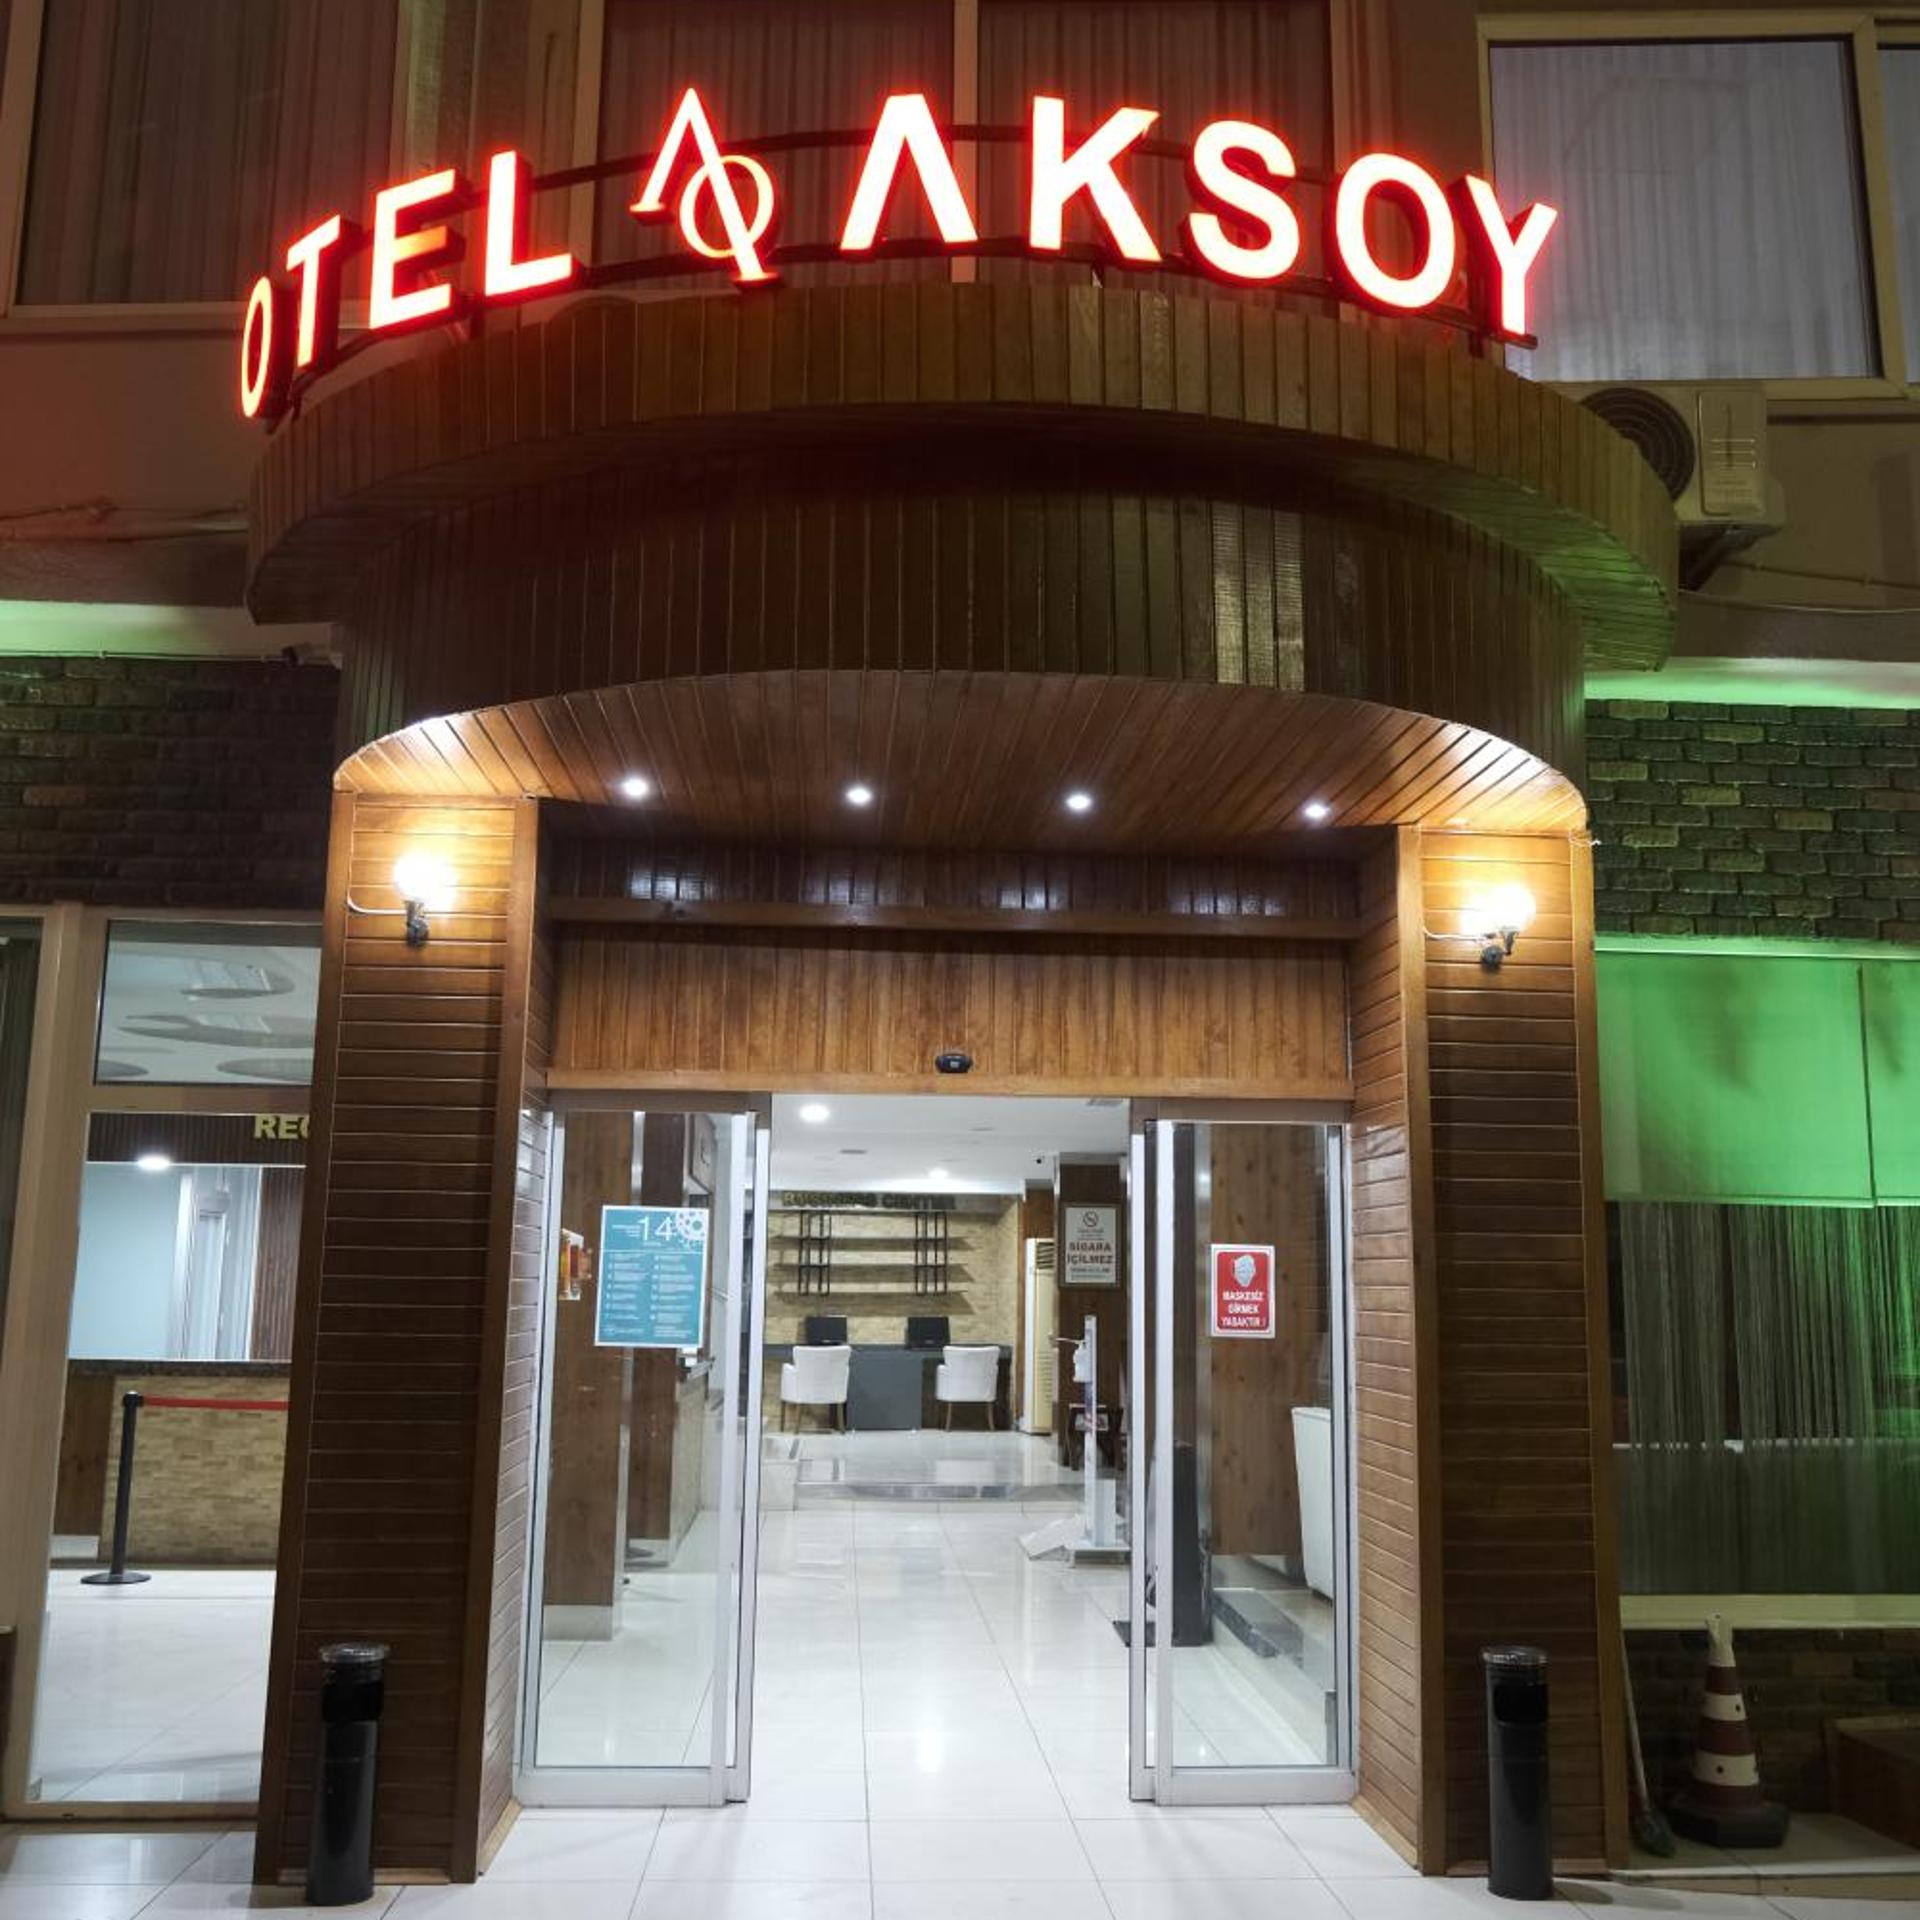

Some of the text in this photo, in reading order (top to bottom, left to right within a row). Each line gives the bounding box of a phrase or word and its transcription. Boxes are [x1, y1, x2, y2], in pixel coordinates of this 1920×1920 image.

[241, 149, 573, 417] OTEL
[840, 93, 1558, 335] AKSOY
[638, 1216, 677, 1241] 14
